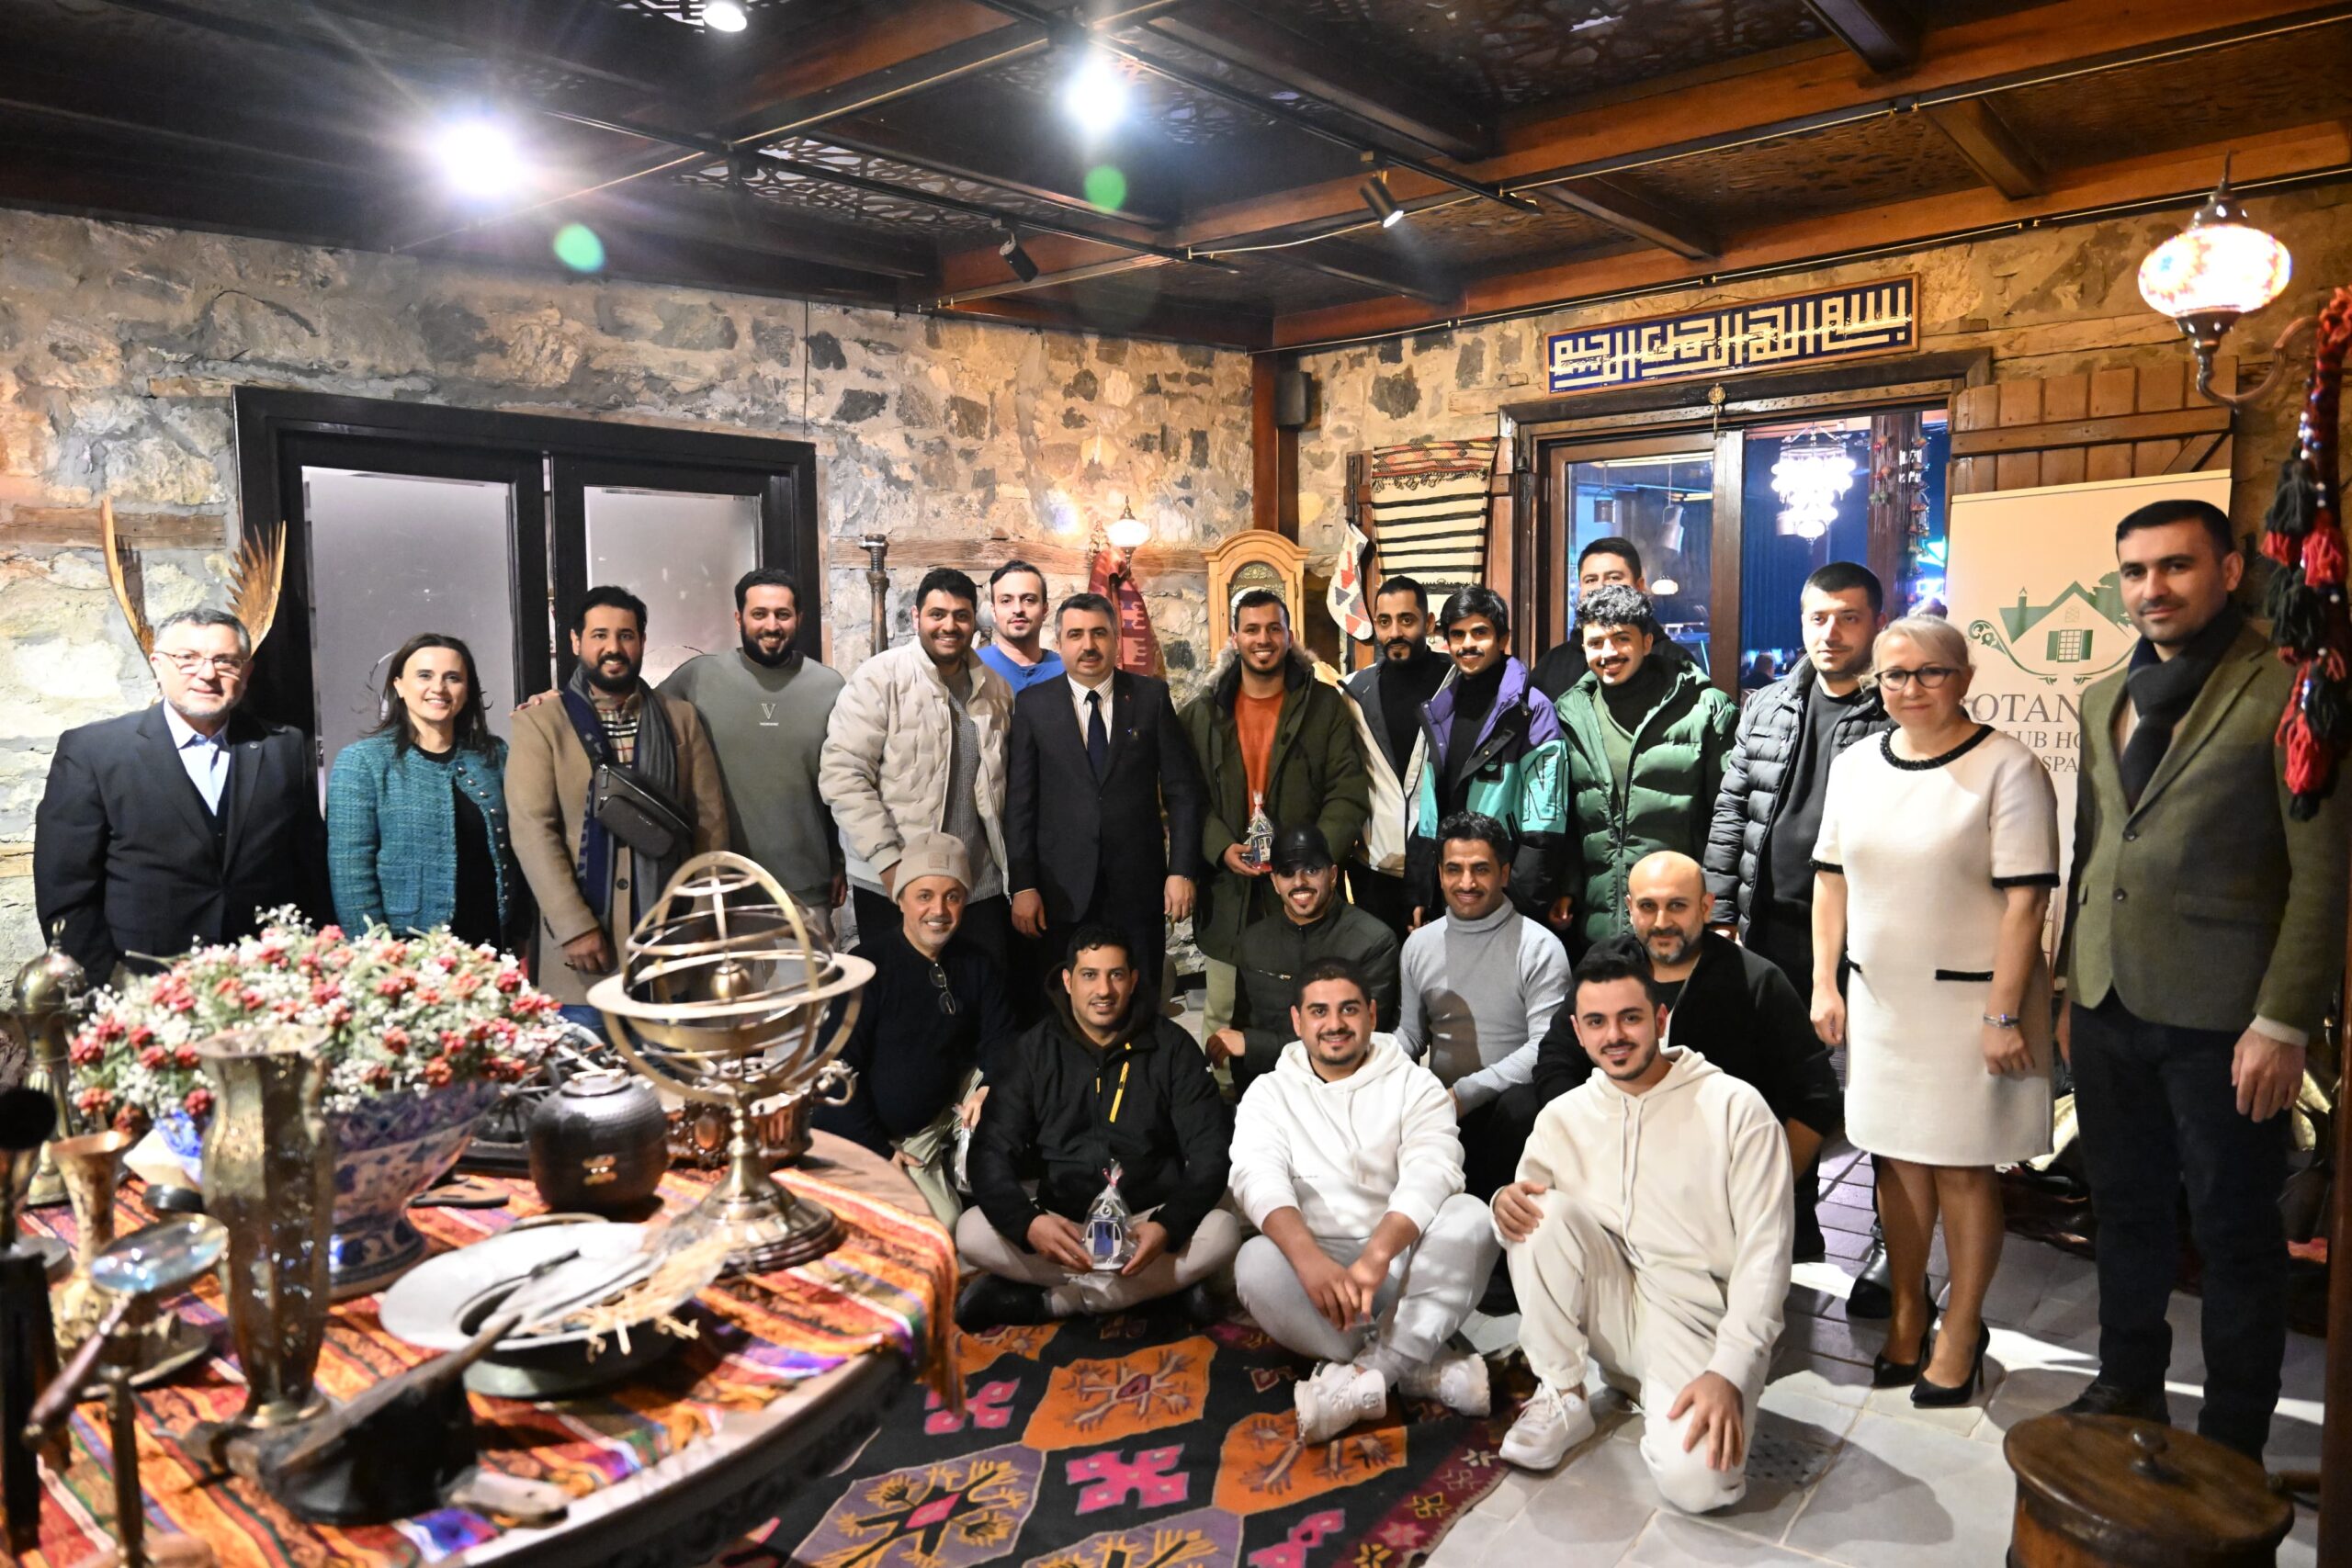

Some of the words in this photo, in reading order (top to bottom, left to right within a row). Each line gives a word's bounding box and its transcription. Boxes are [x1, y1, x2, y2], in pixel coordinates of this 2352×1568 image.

[761, 704, 775, 719] V
[1972, 694, 2082, 722] OTAN
[2005, 730, 2047, 748] UB
[2041, 756, 2079, 772] SPA
[1522, 754, 1568, 821] N
